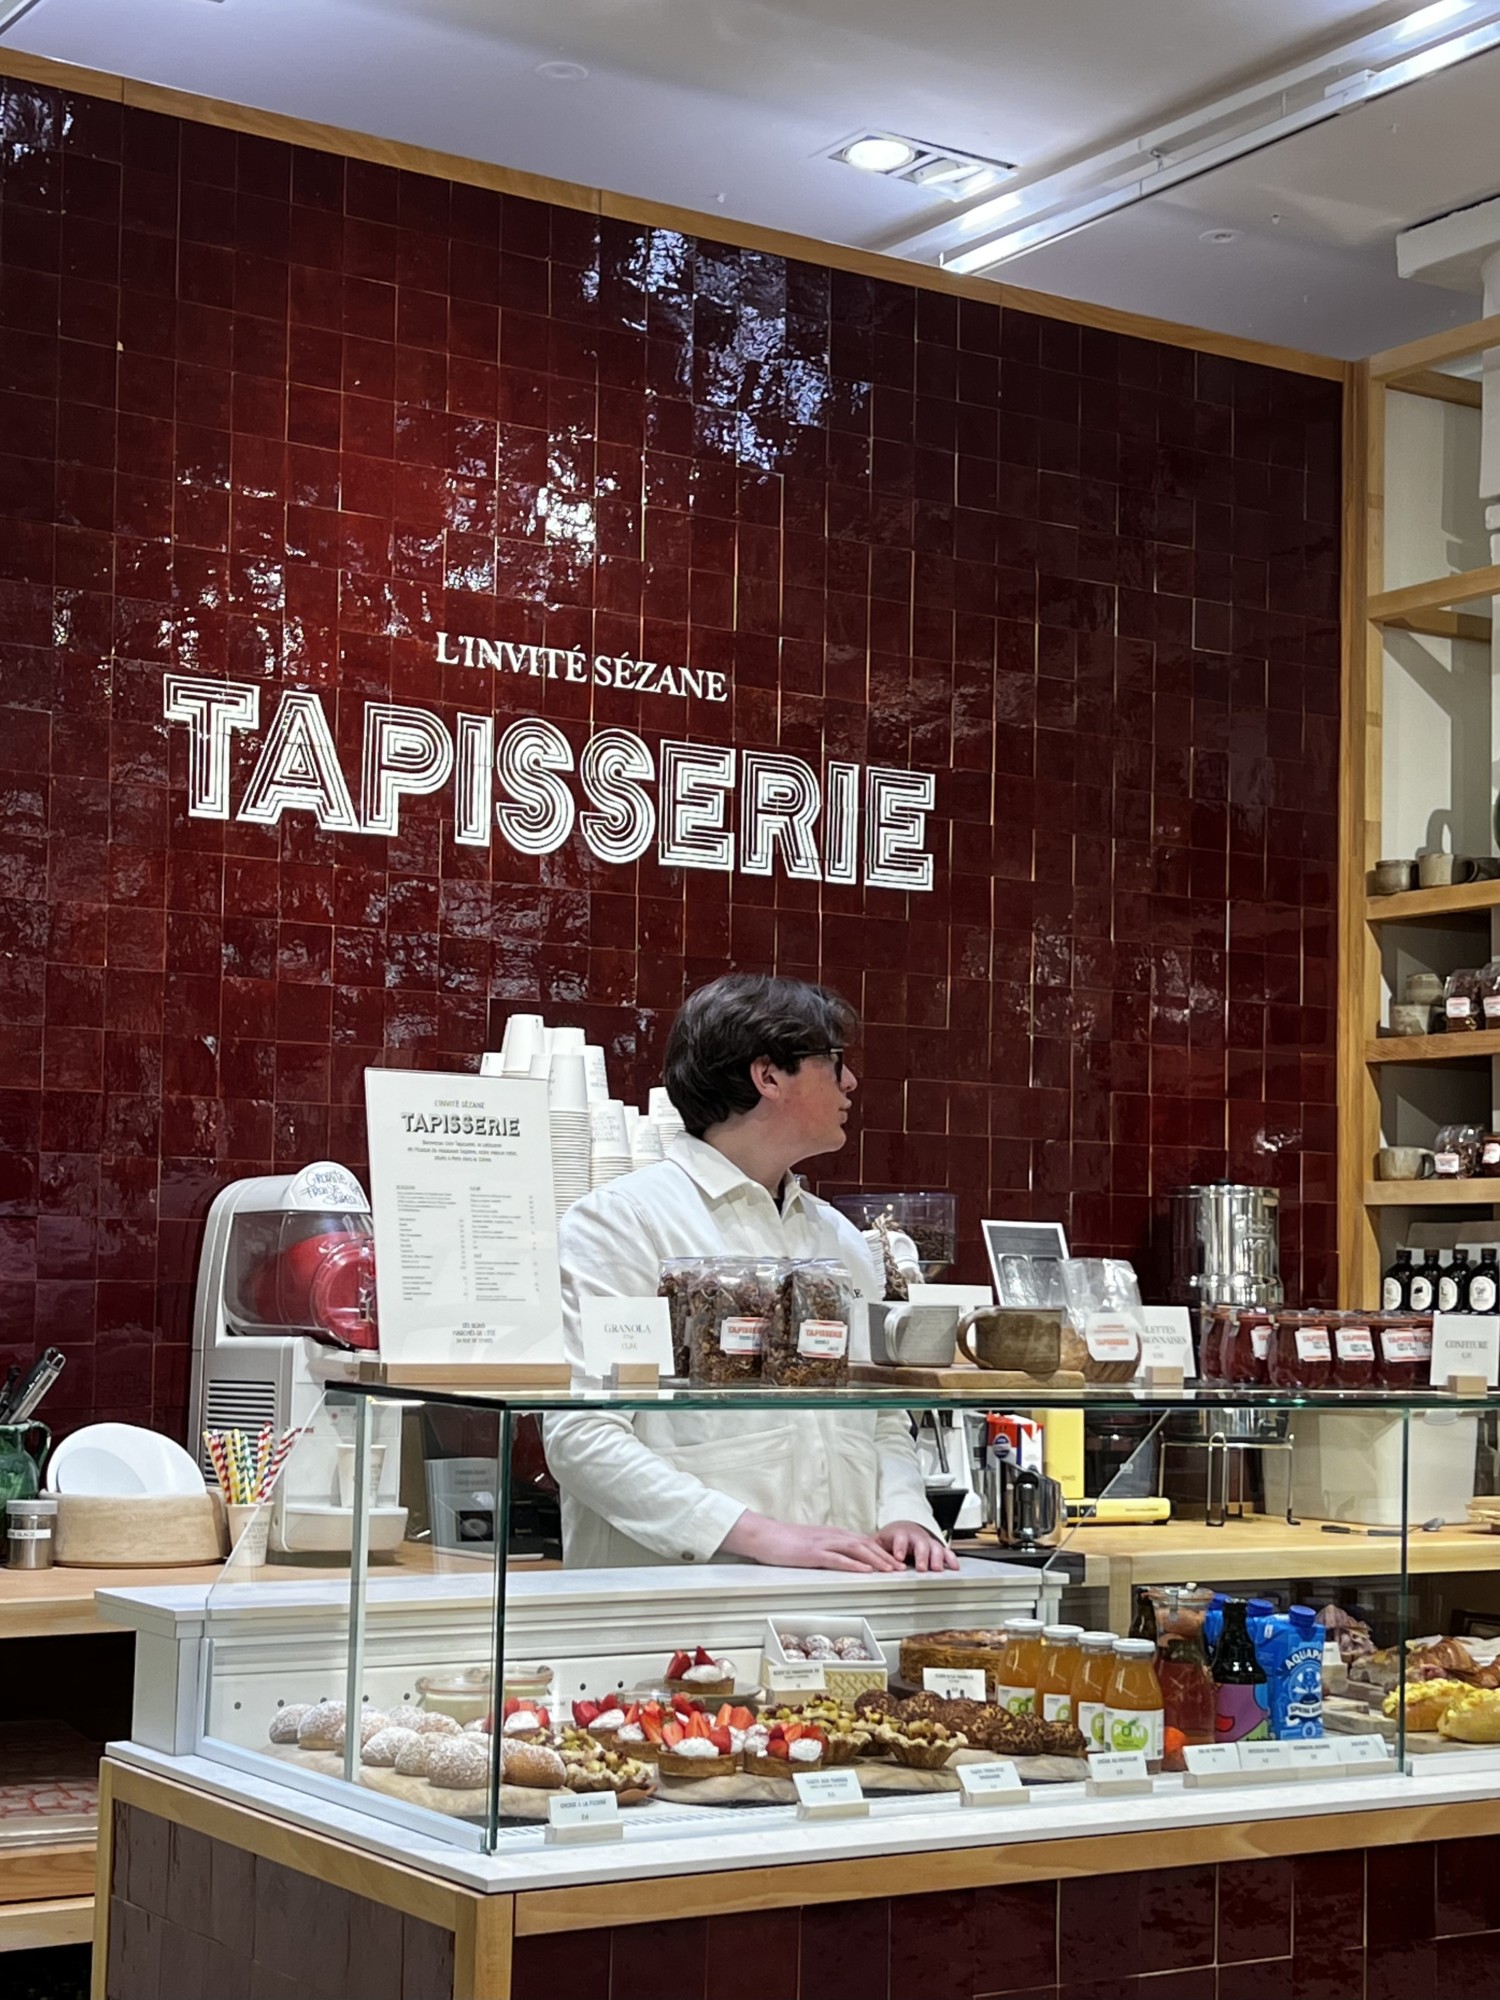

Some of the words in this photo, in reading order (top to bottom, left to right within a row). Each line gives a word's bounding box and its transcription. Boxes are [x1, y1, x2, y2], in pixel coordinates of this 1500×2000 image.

[435, 631, 587, 685] L'INVITÉ
[593, 651, 728, 704] SÉZANE
[163, 673, 936, 892] TAPISSERIE
[401, 1111, 521, 1137] TAPISSERIE
[603, 1323, 652, 1334] GRANOLA
[1444, 1340, 1488, 1349] CONFITURE
[1113, 1724, 1145, 1739] POM
